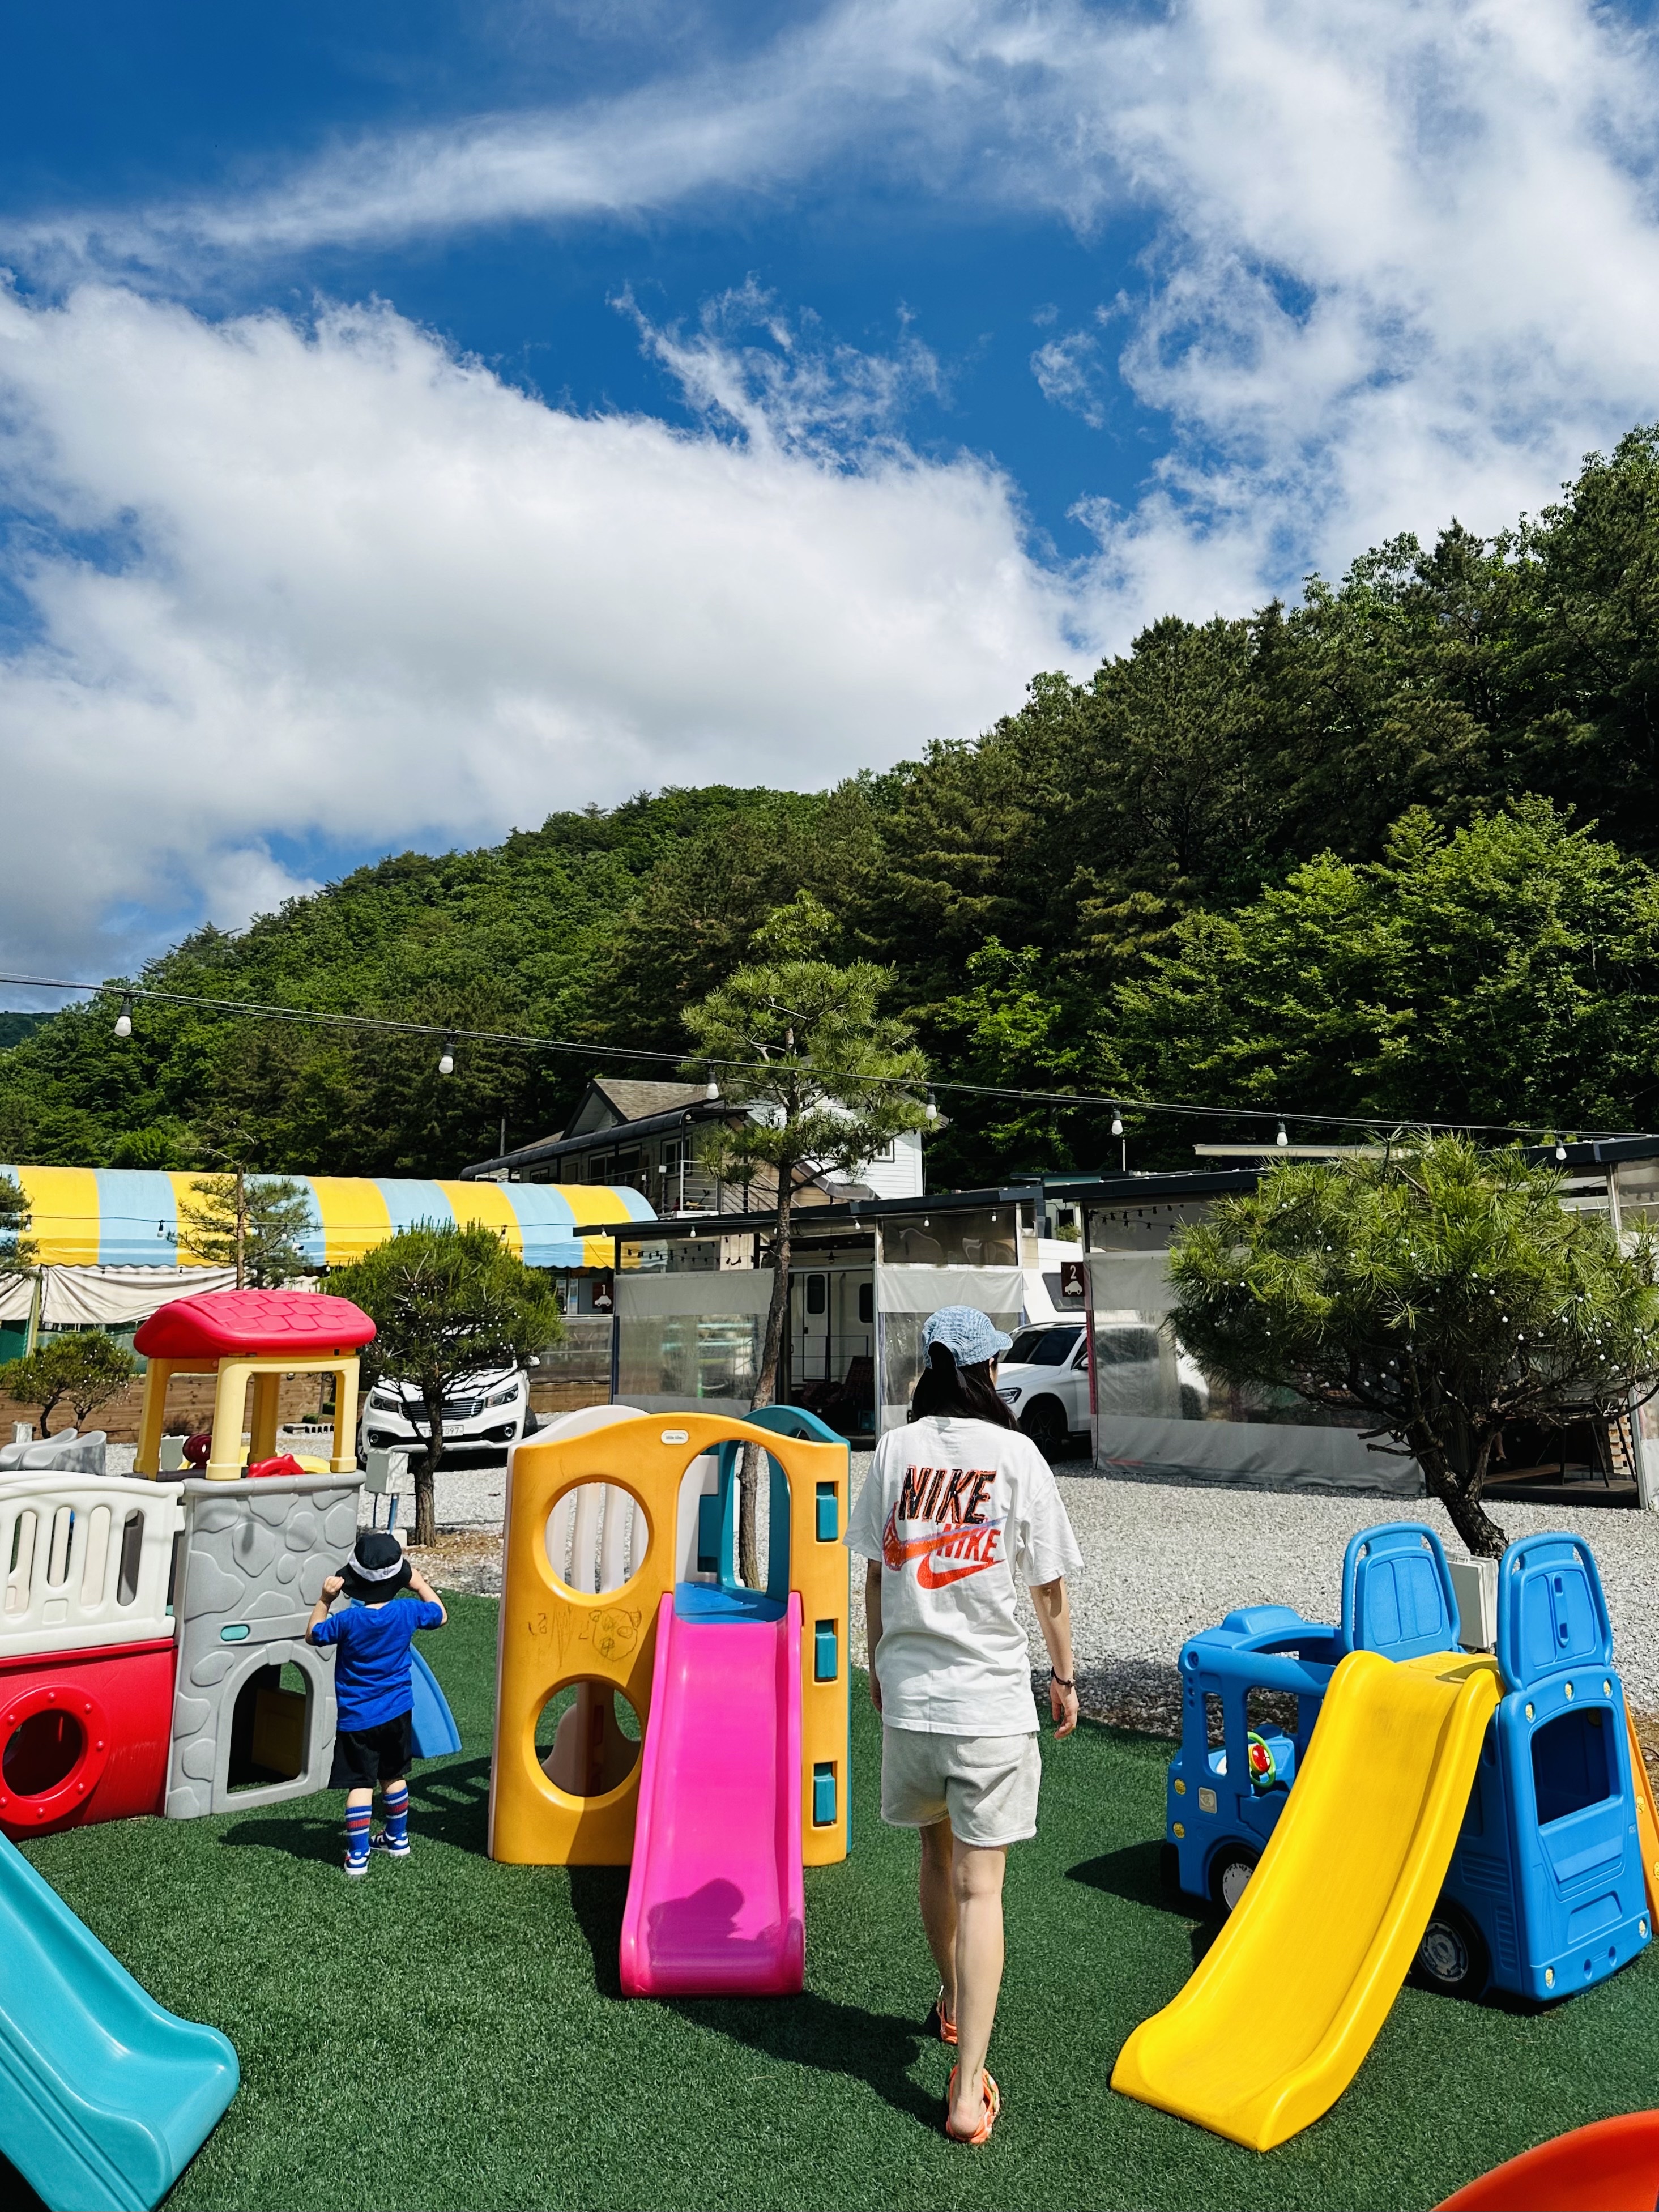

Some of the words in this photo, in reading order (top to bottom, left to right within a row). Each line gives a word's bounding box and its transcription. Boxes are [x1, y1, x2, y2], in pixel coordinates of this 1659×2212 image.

[1069, 1264, 1077, 1280] 2
[602, 1284, 606, 1295] 1
[898, 1465, 997, 1524] NIKE
